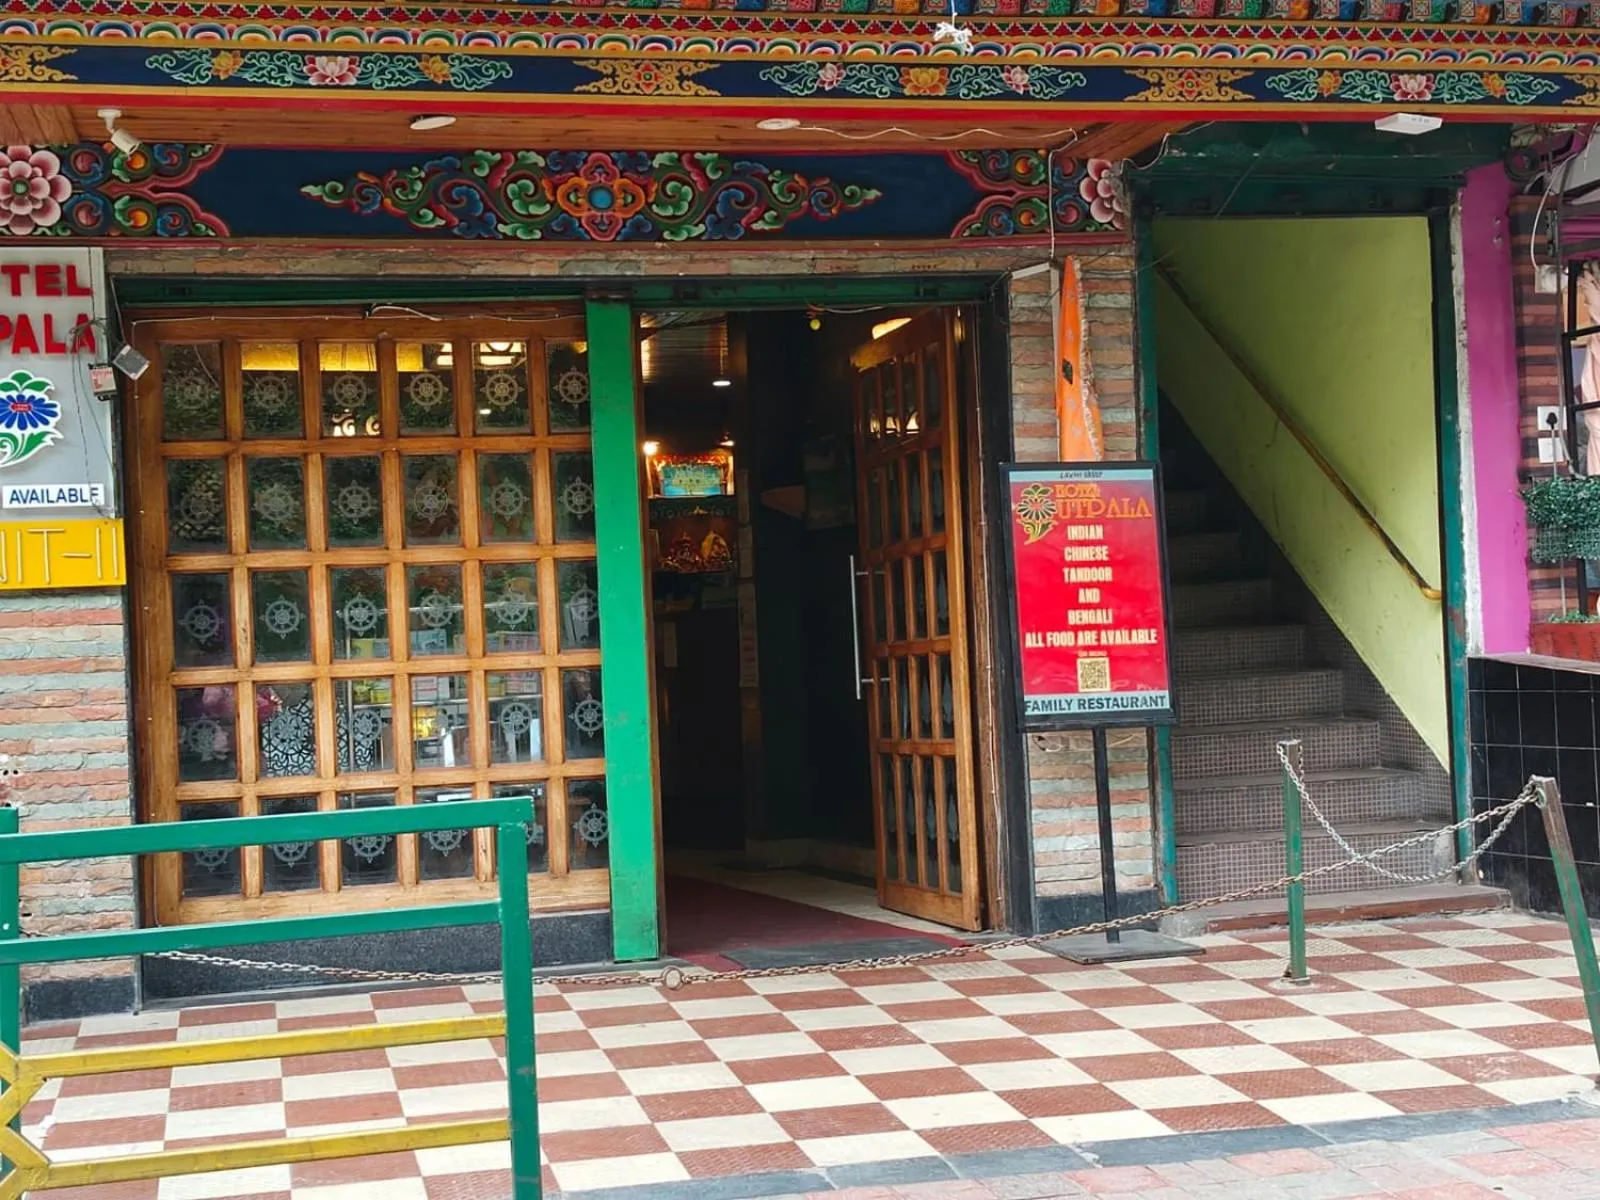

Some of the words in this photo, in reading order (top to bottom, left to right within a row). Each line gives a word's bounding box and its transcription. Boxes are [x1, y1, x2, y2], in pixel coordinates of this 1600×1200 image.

[1, 264, 93, 296] TEL
[1067, 525, 1104, 540] INDIAN
[1064, 546, 1109, 561] CHINESE
[1063, 567, 1112, 582] TANDOOR
[1079, 588, 1100, 603] AND
[1068, 609, 1112, 625] BENGALI
[1025, 632, 1044, 648] ALL
[1046, 631, 1075, 647] FOOD
[1077, 630, 1099, 646] ARE
[1101, 628, 1157, 645] AVAILABLE
[1025, 698, 1073, 712] FAMILY
[1078, 695, 1166, 709] RESTAURANT
